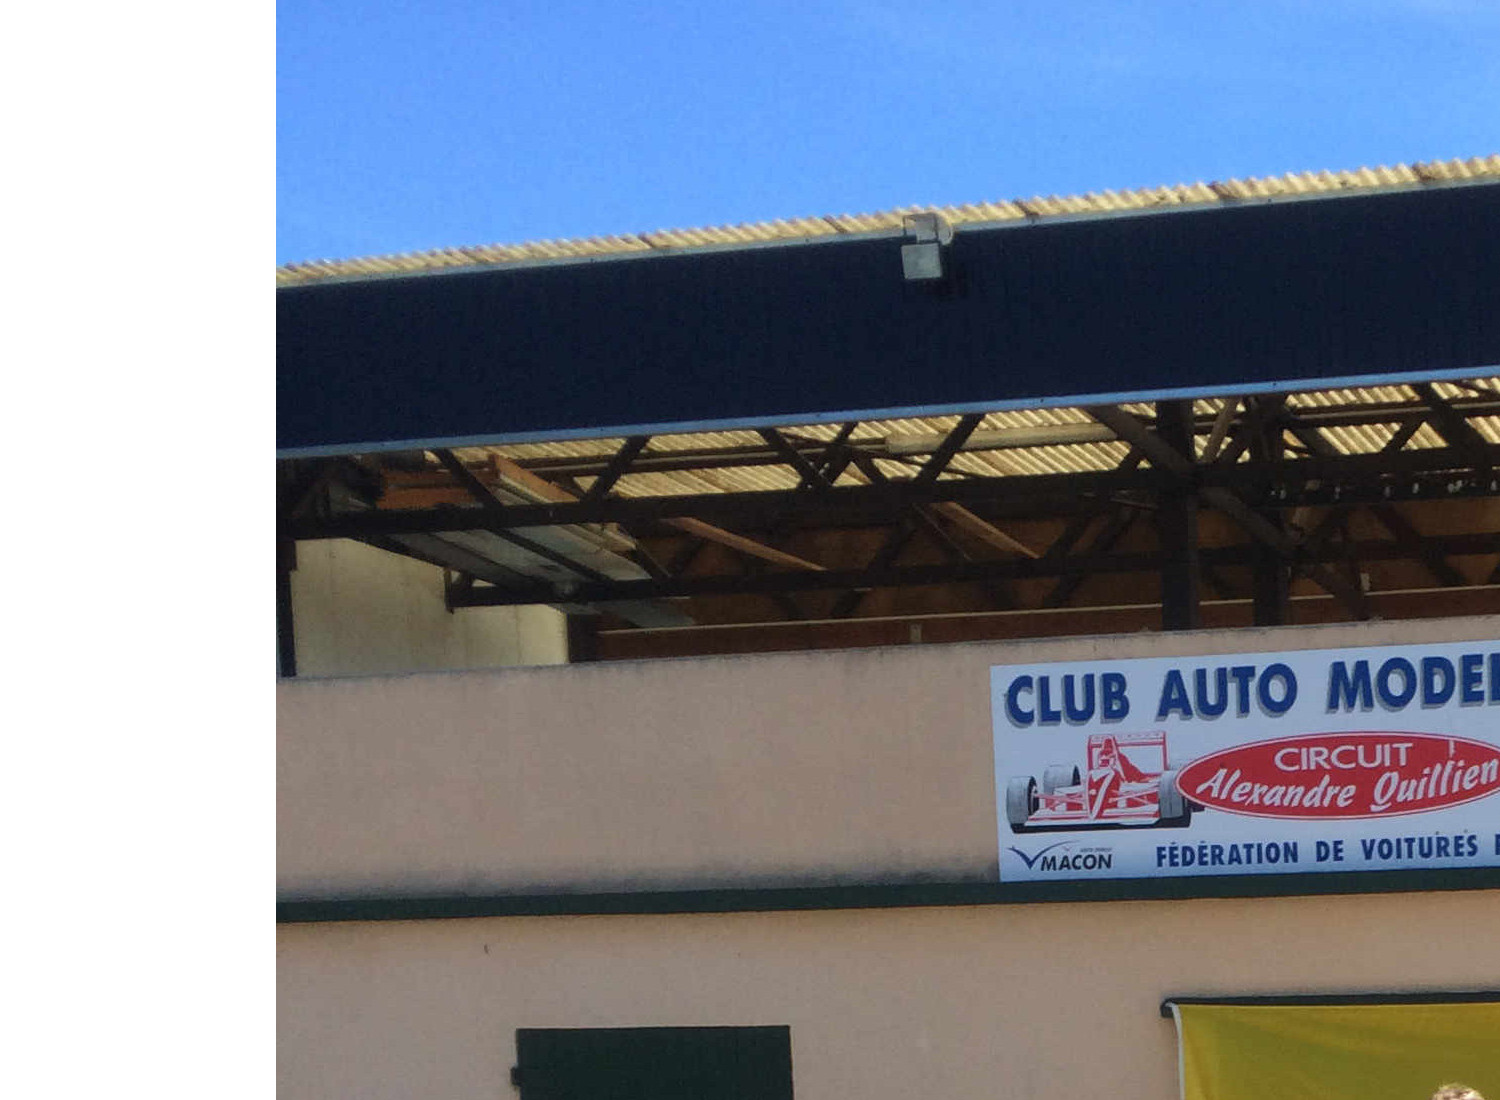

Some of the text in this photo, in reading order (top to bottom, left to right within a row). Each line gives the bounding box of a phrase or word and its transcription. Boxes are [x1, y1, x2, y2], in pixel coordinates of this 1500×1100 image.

[1005, 671, 1130, 727] CLUB
[1156, 663, 1298, 721] AUTO
[1274, 742, 1414, 772] CIRCUIT
[1195, 757, 1499, 812] Alexandre Quillien
[1156, 840, 1299, 868] FÉDÉRATION
[1316, 839, 1344, 863] DE
[1361, 833, 1478, 861] VOITURES
